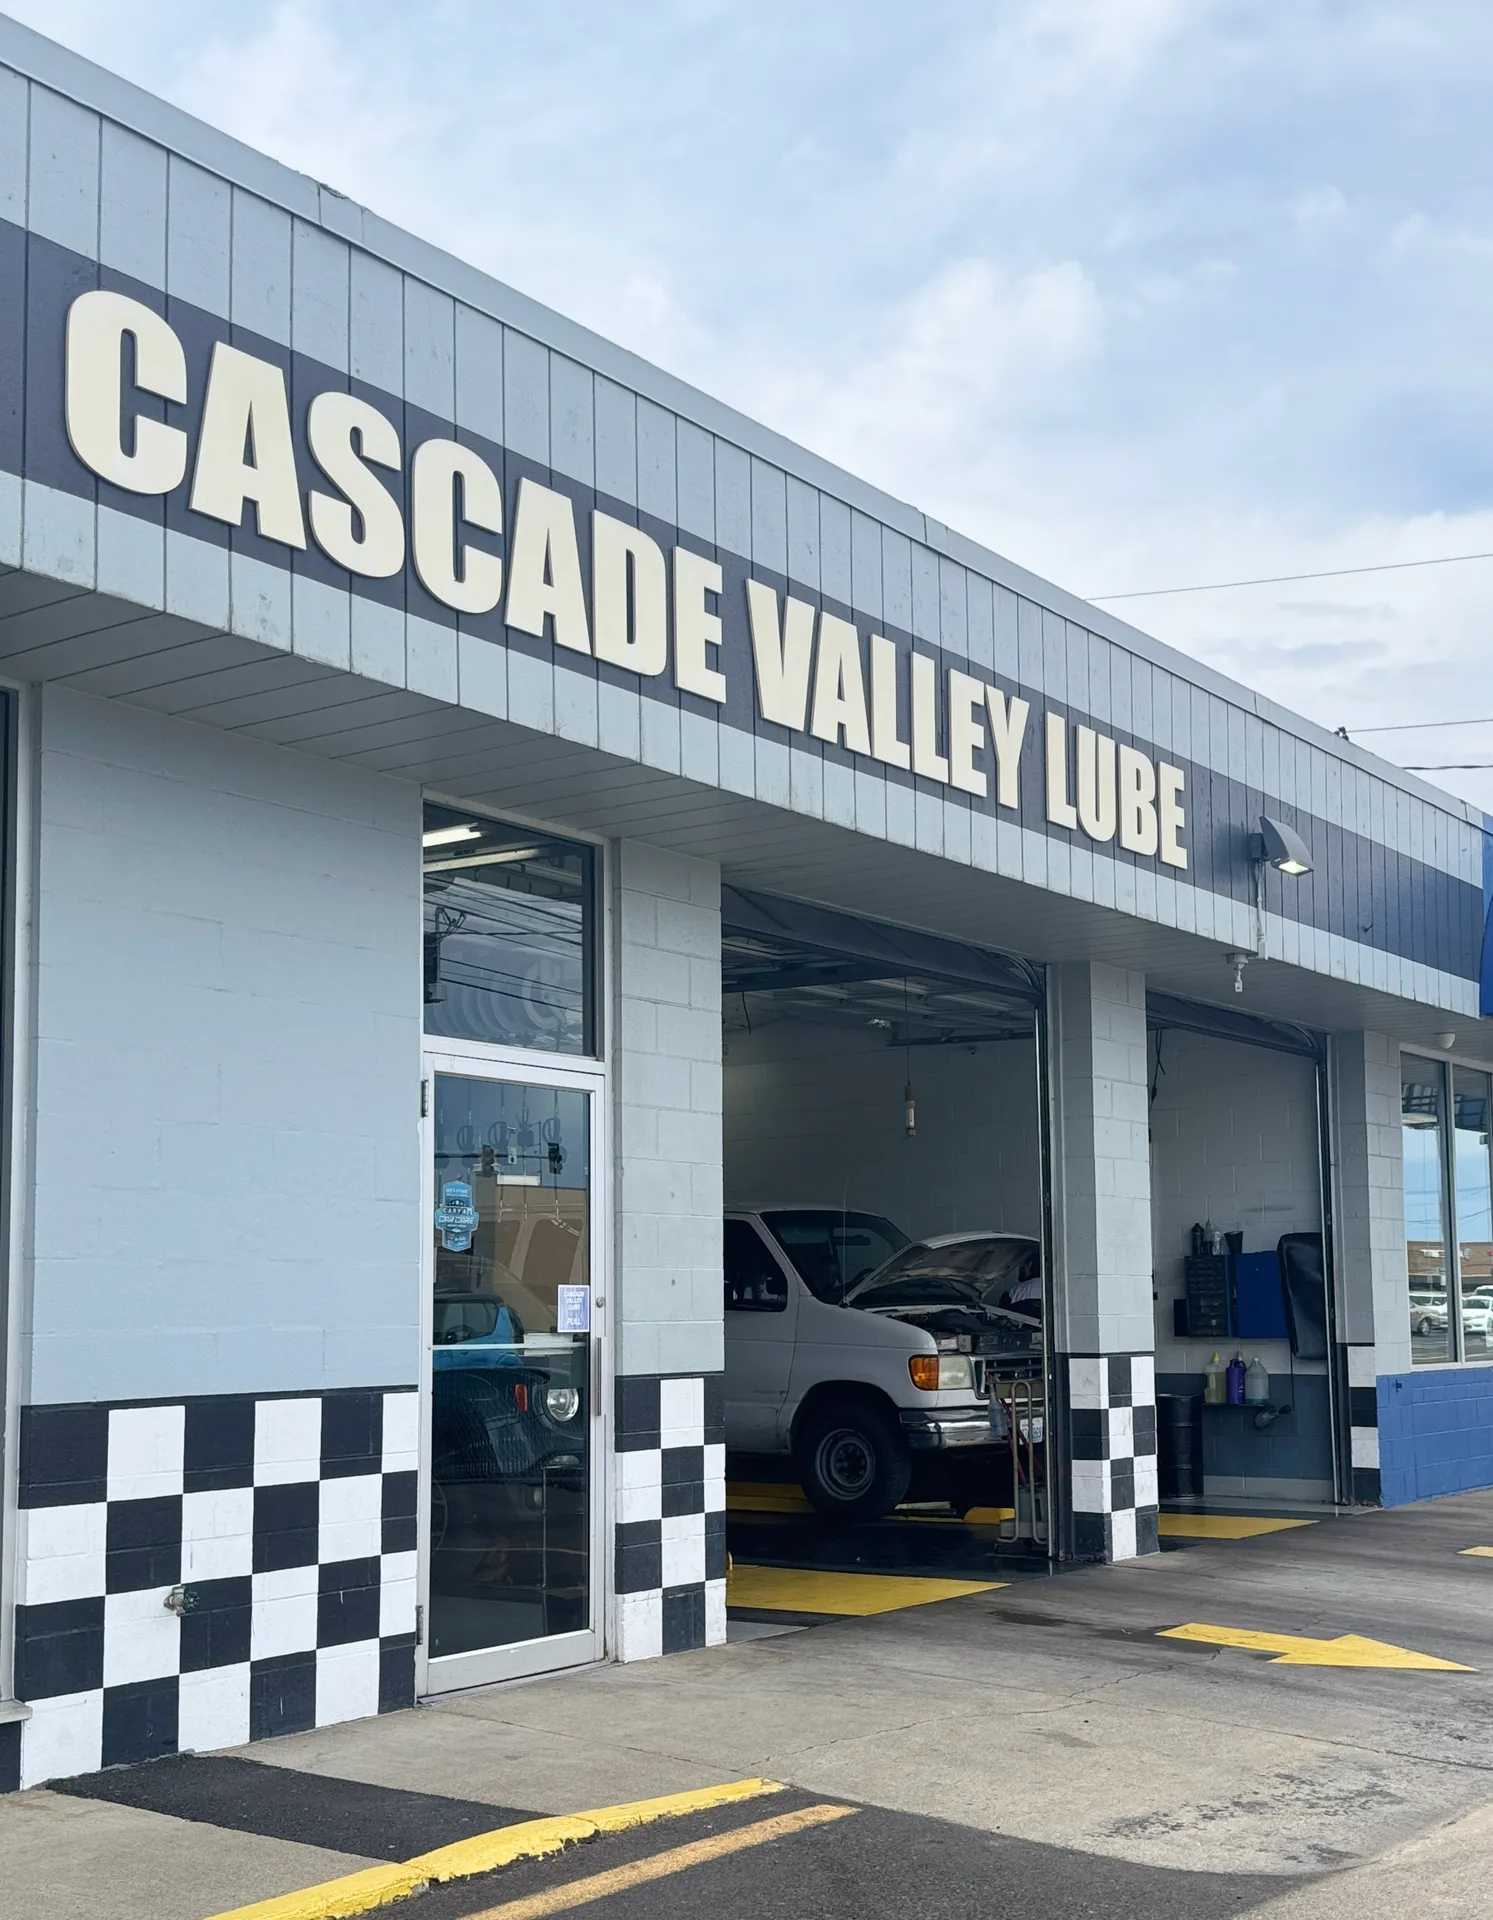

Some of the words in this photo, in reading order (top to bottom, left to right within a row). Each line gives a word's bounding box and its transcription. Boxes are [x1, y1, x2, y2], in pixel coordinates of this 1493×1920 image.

[65, 289, 727, 704] CASCADE
[745, 578, 1030, 809] VALLEY
[1045, 711, 1188, 870] LUBE
